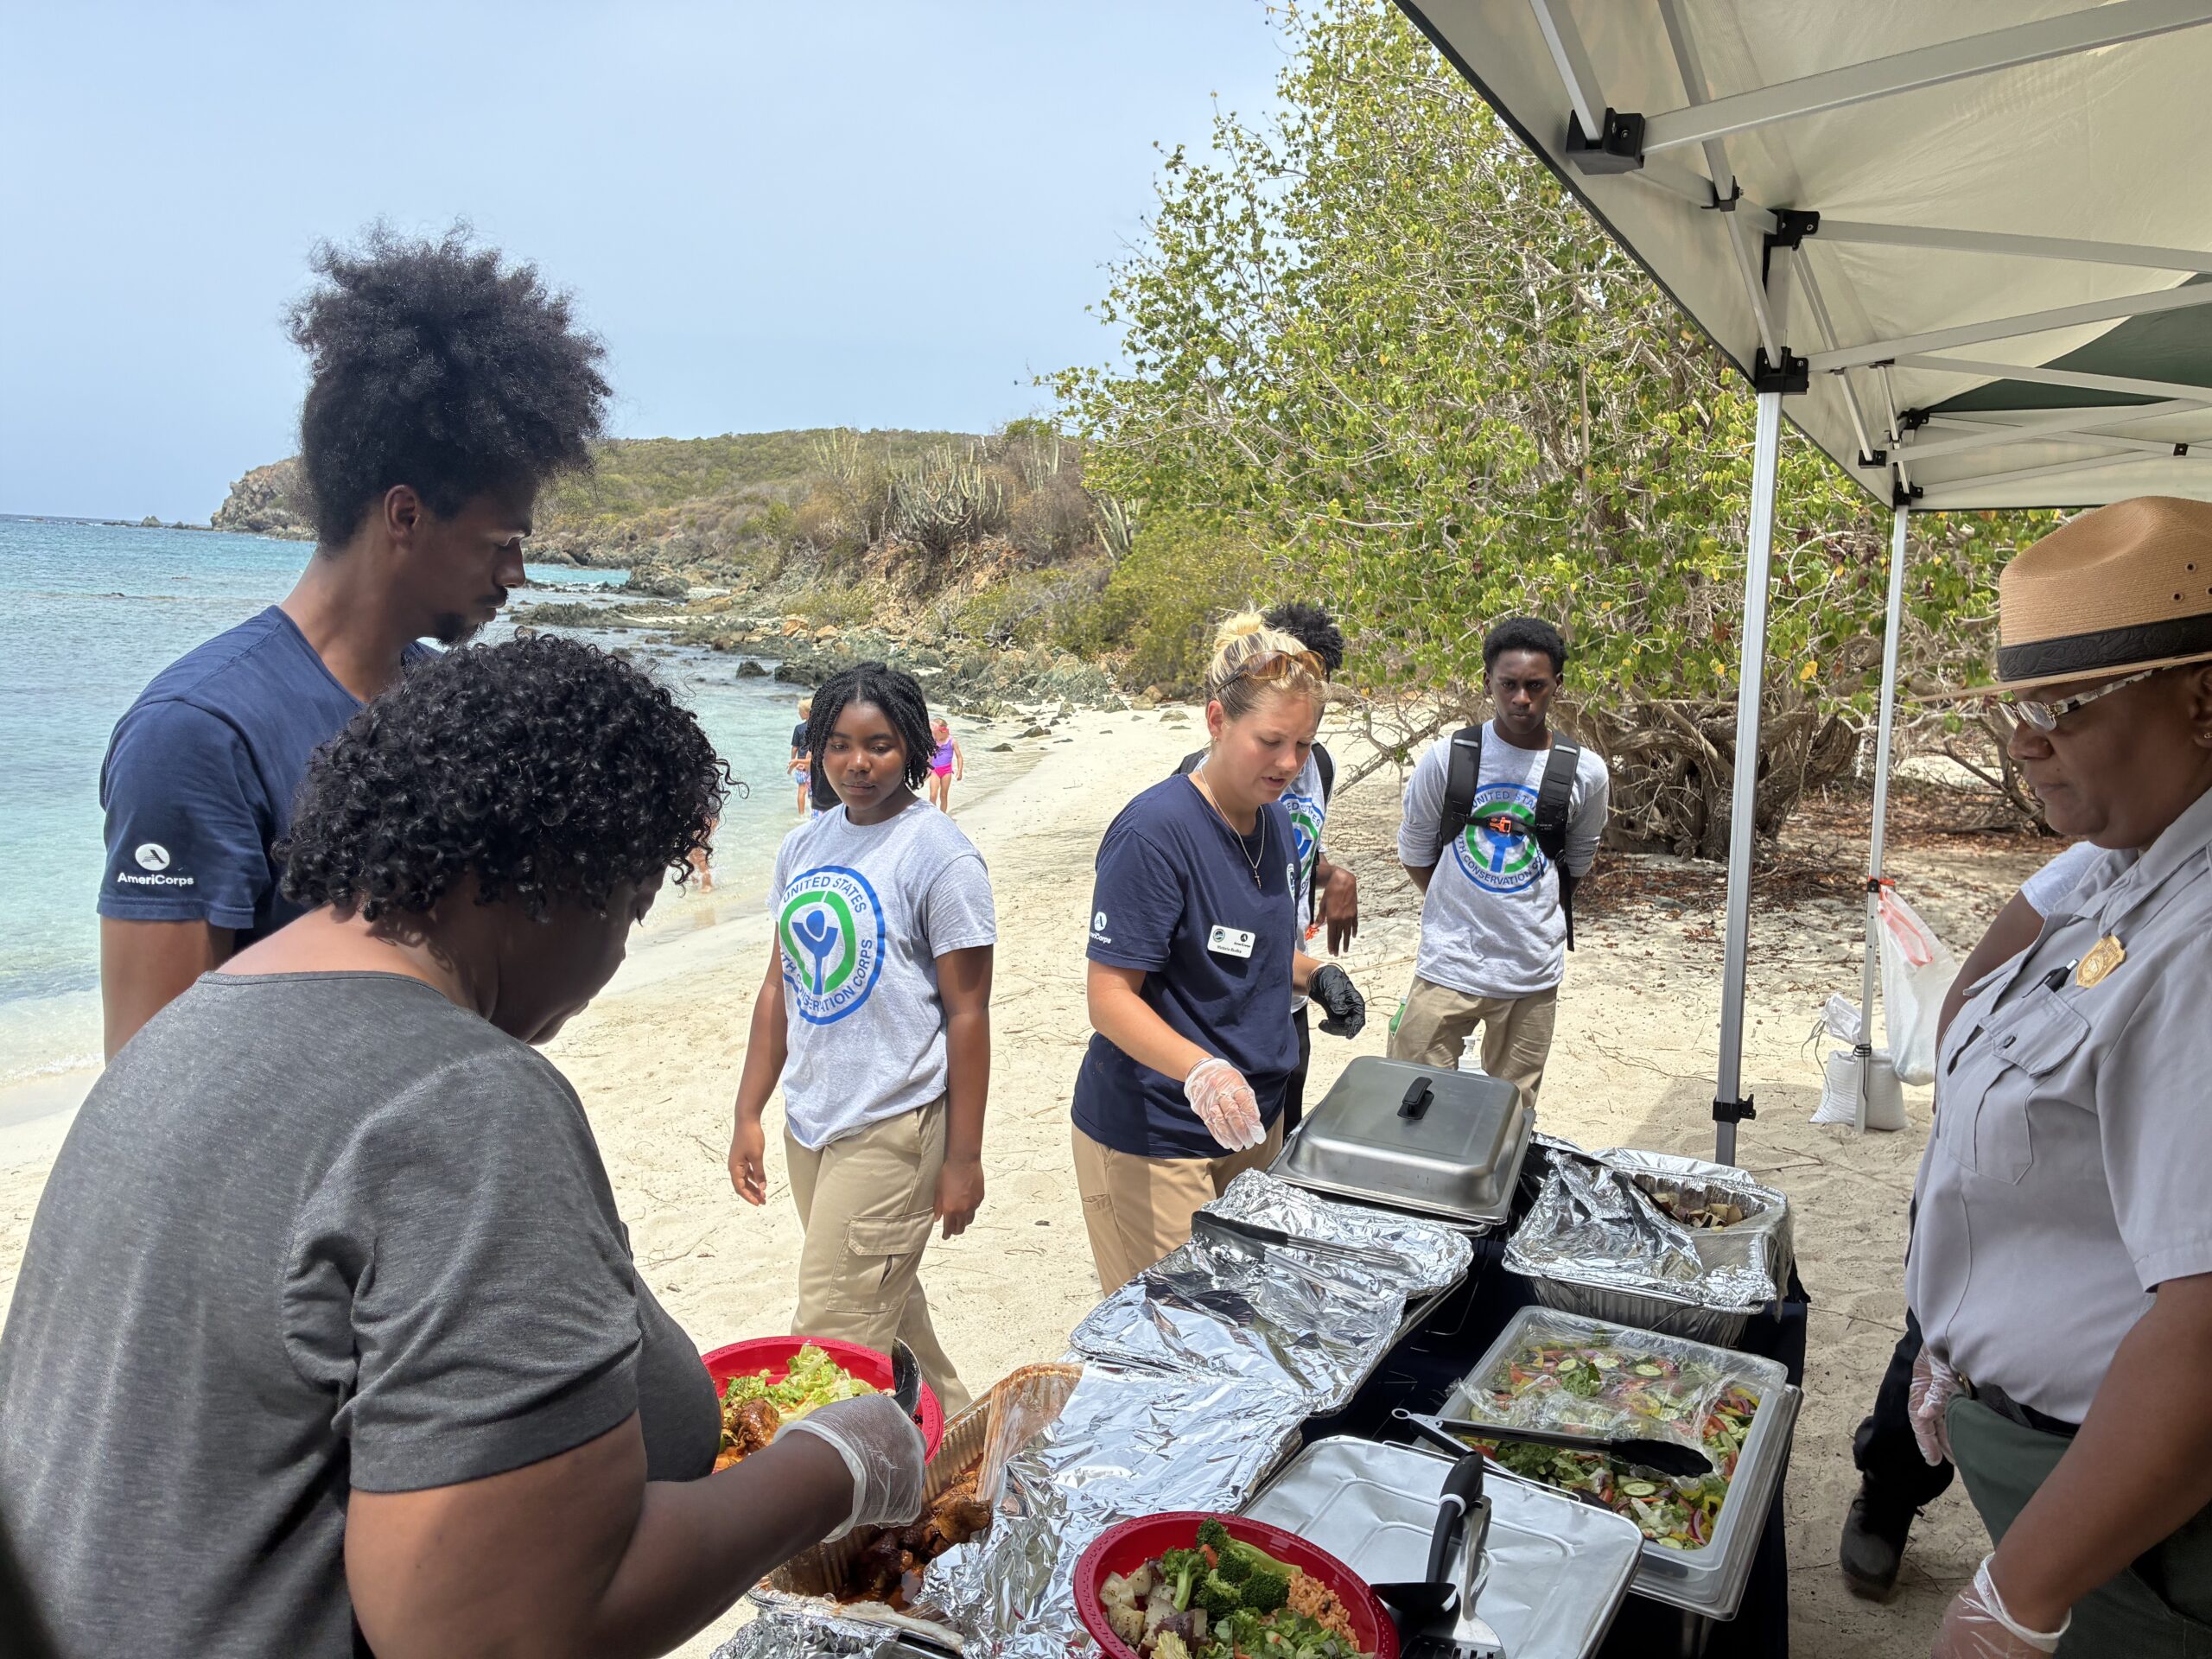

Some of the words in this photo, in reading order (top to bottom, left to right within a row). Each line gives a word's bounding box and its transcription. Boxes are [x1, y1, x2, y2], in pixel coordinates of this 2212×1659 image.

[1472, 791, 1510, 808] UNITED
[1515, 793, 1536, 810] STA
[118, 872, 194, 887] AmeriCorps
[1464, 855, 1532, 886] CONSERVATION
[784, 876, 830, 904] UNITED
[832, 877, 867, 913] STATES
[853, 939, 873, 988] CORPS
